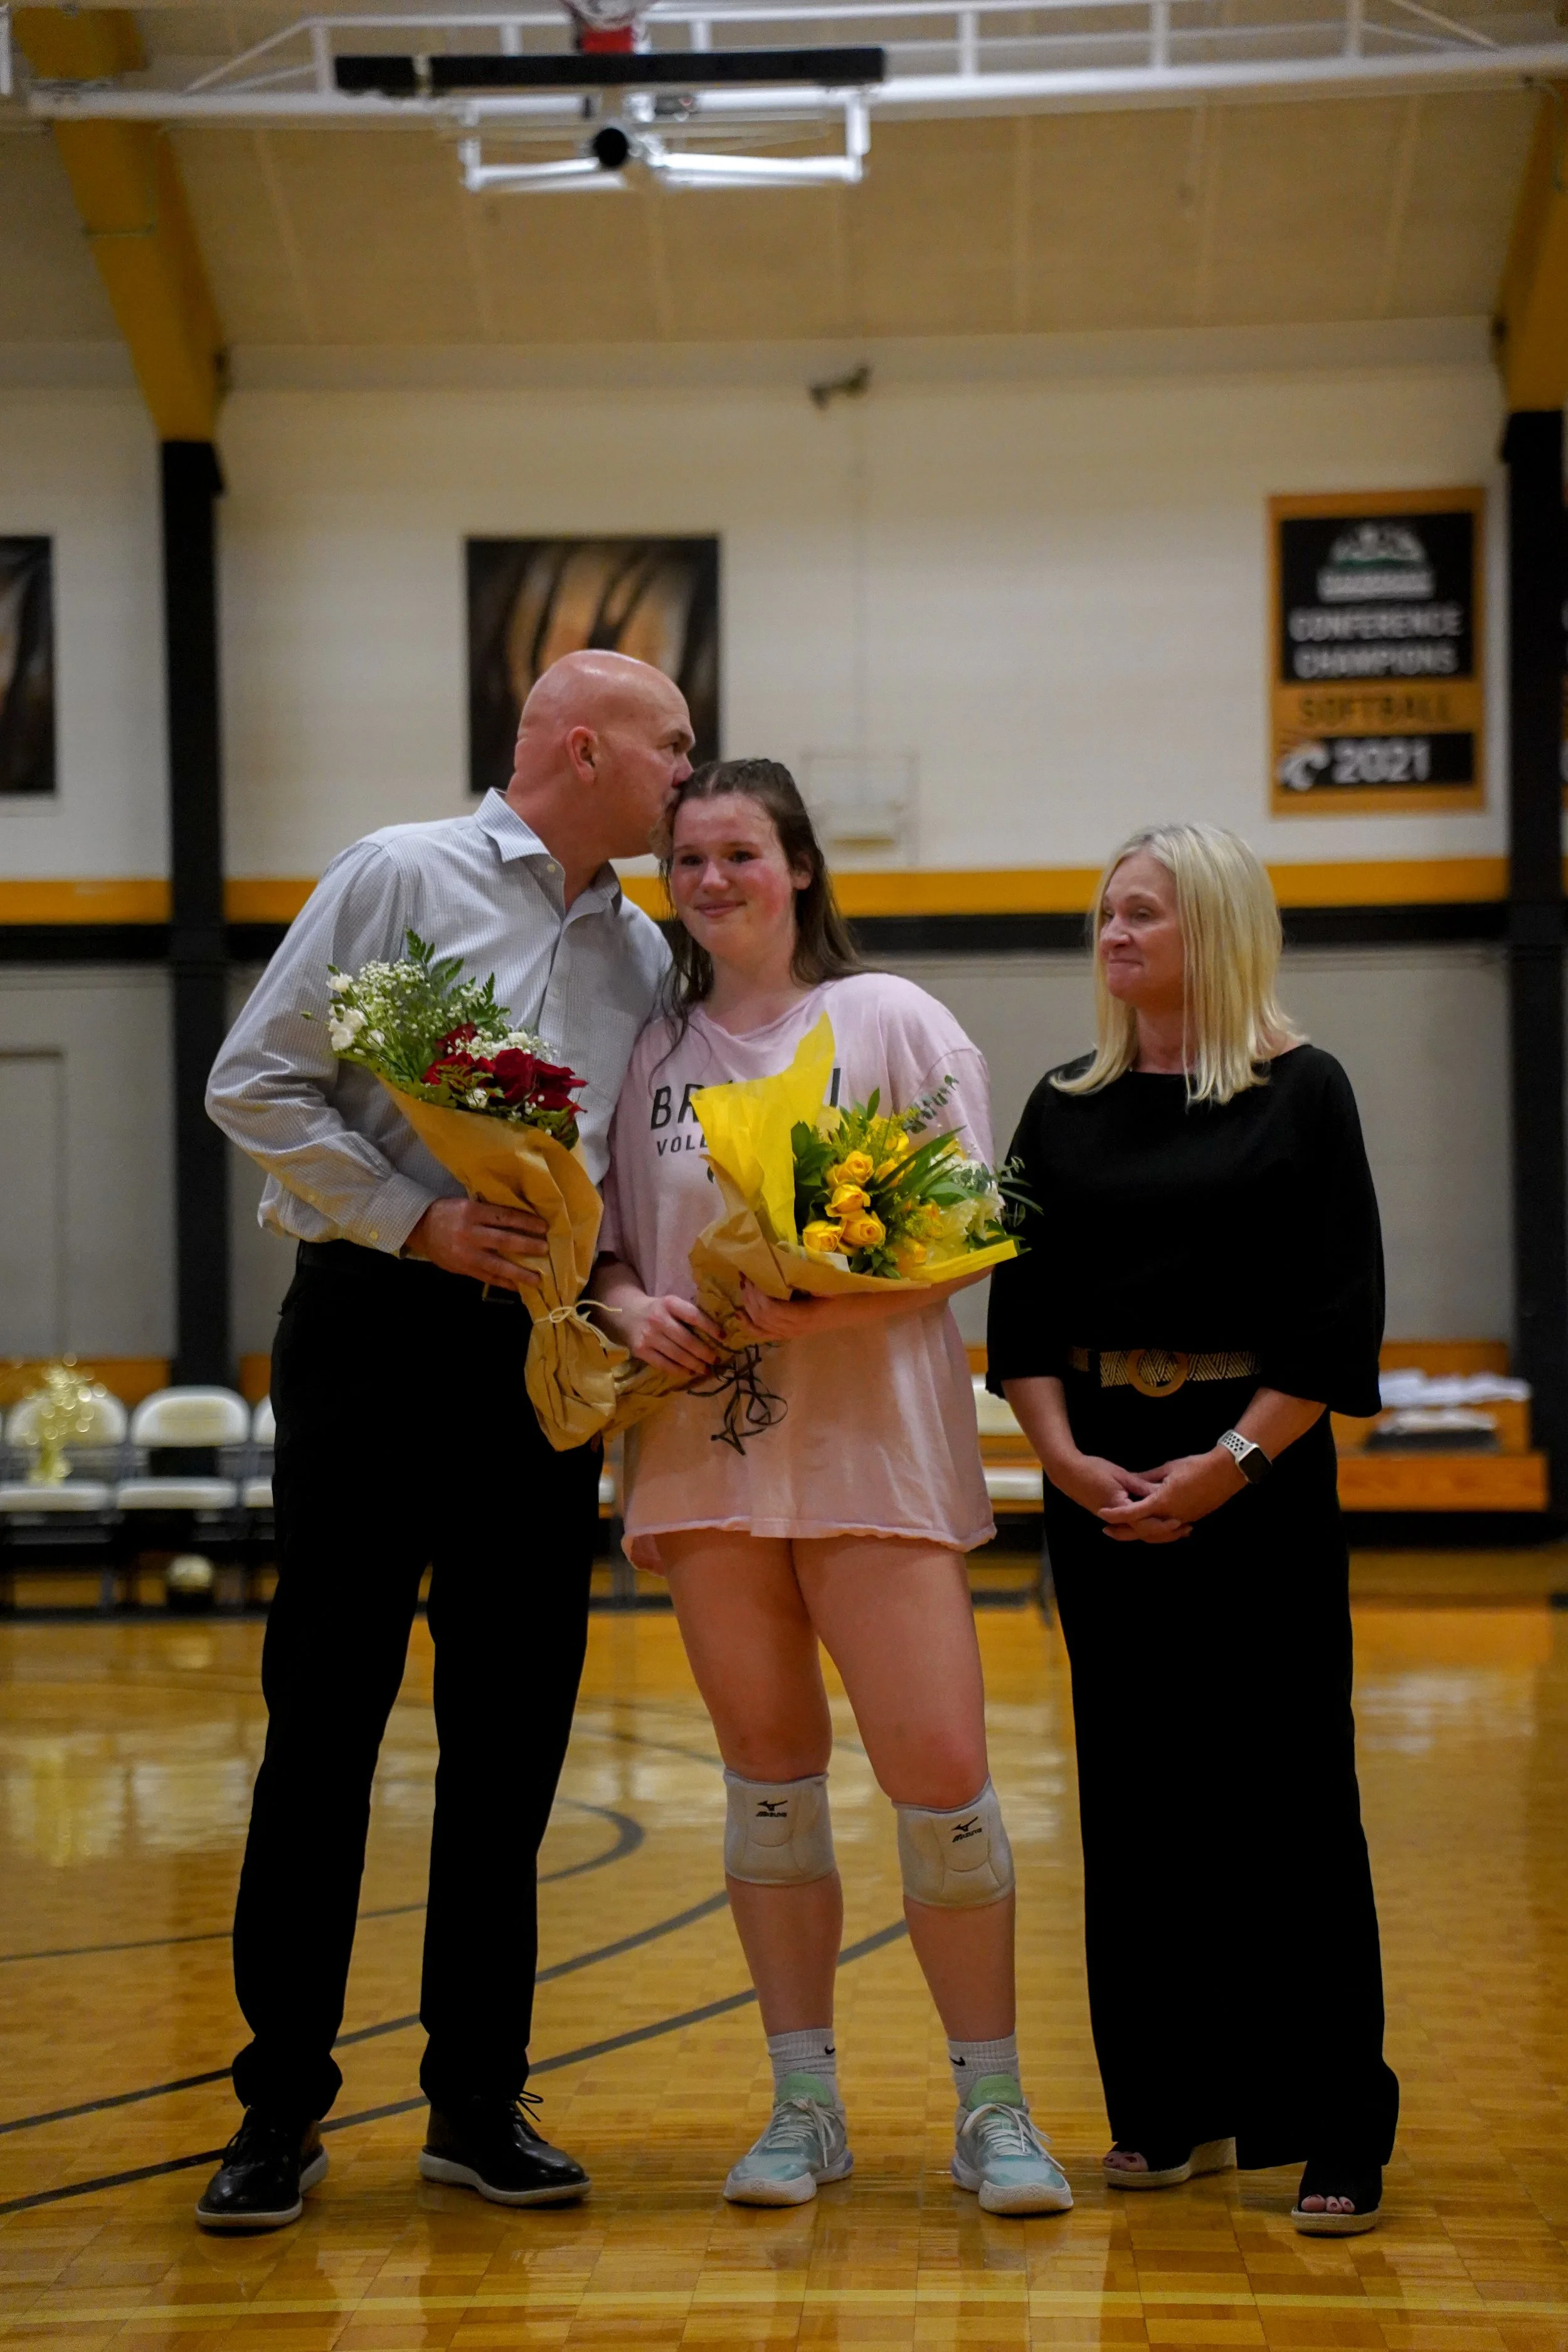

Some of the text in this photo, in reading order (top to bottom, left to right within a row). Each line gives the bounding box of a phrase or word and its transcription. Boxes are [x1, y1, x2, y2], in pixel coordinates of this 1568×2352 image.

[1290, 605, 1461, 640] CONFERENCE
[1294, 642, 1457, 677] CHAMPIONS
[1300, 692, 1450, 723] SOFTBALL
[1332, 739, 1430, 783] 2021
